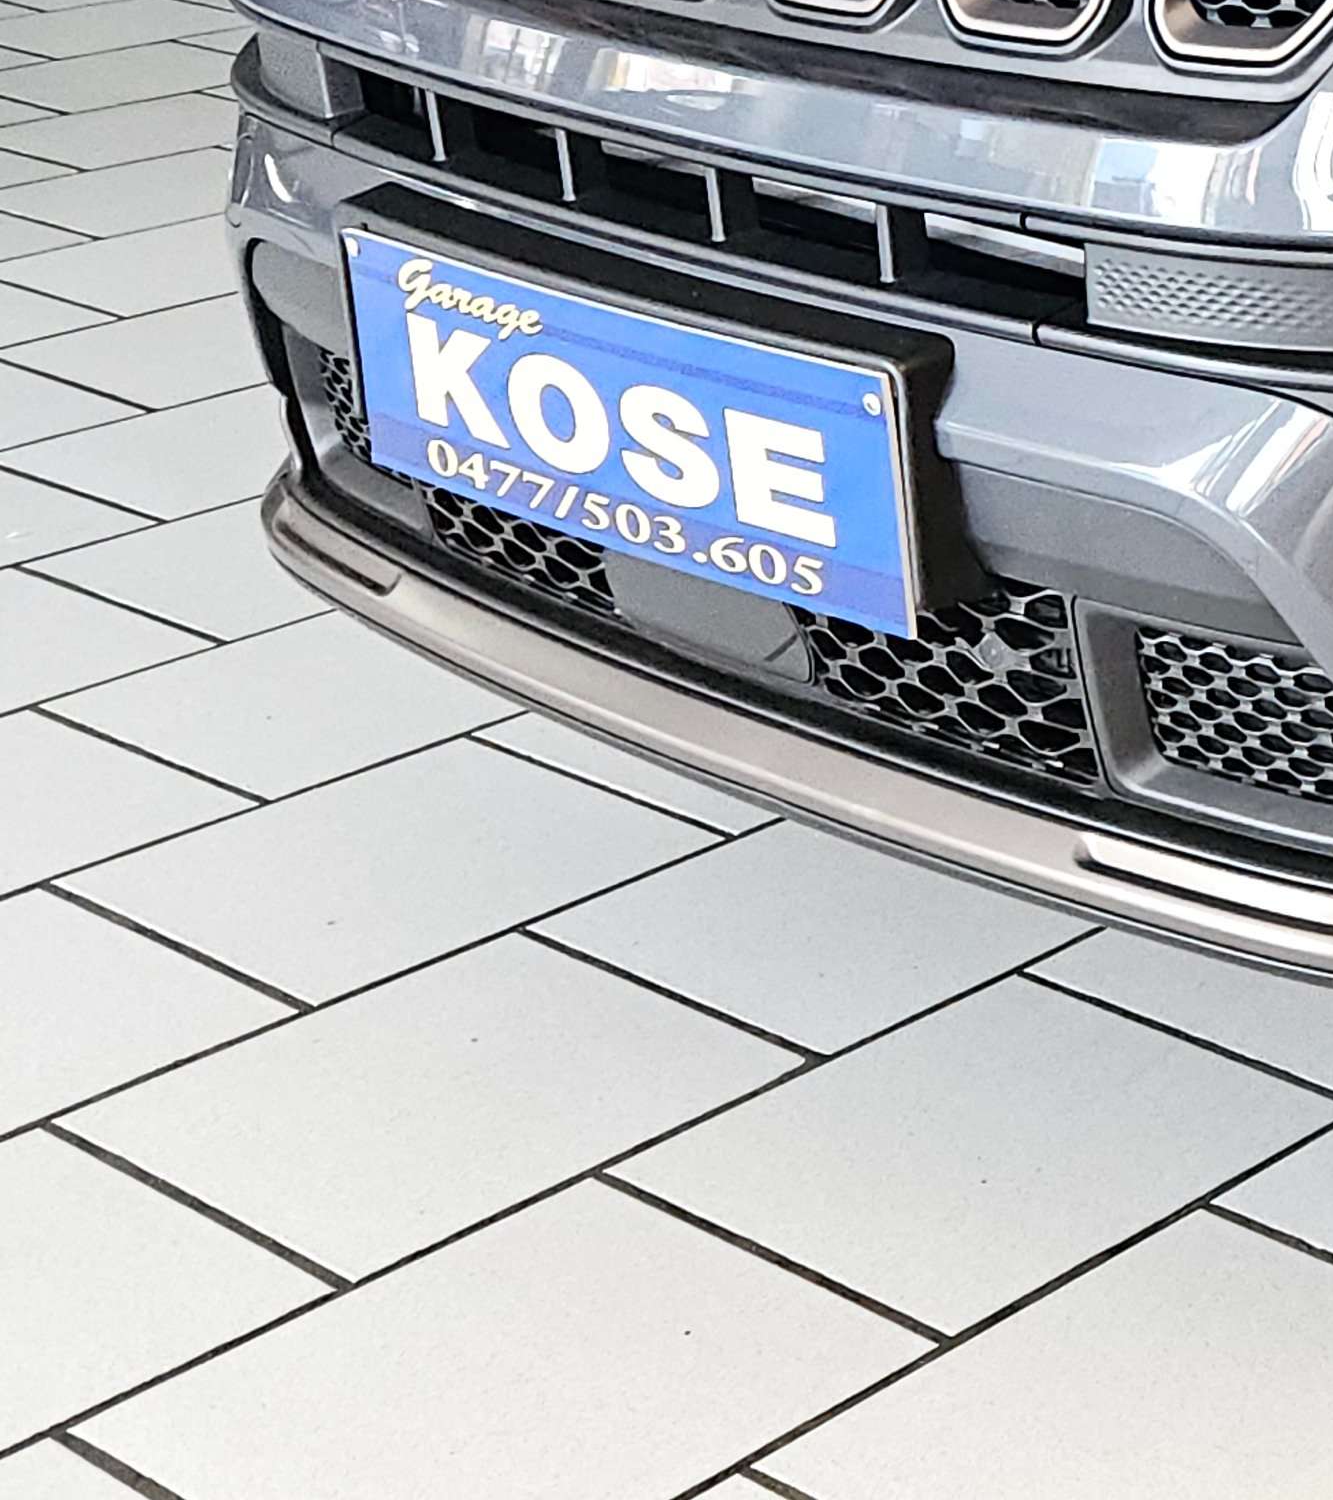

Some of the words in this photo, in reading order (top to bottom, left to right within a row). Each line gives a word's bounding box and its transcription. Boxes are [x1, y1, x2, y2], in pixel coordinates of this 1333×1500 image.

[397, 258, 543, 340] Garage
[405, 312, 836, 547] KOSE
[426, 438, 824, 595] 0477/503.605
